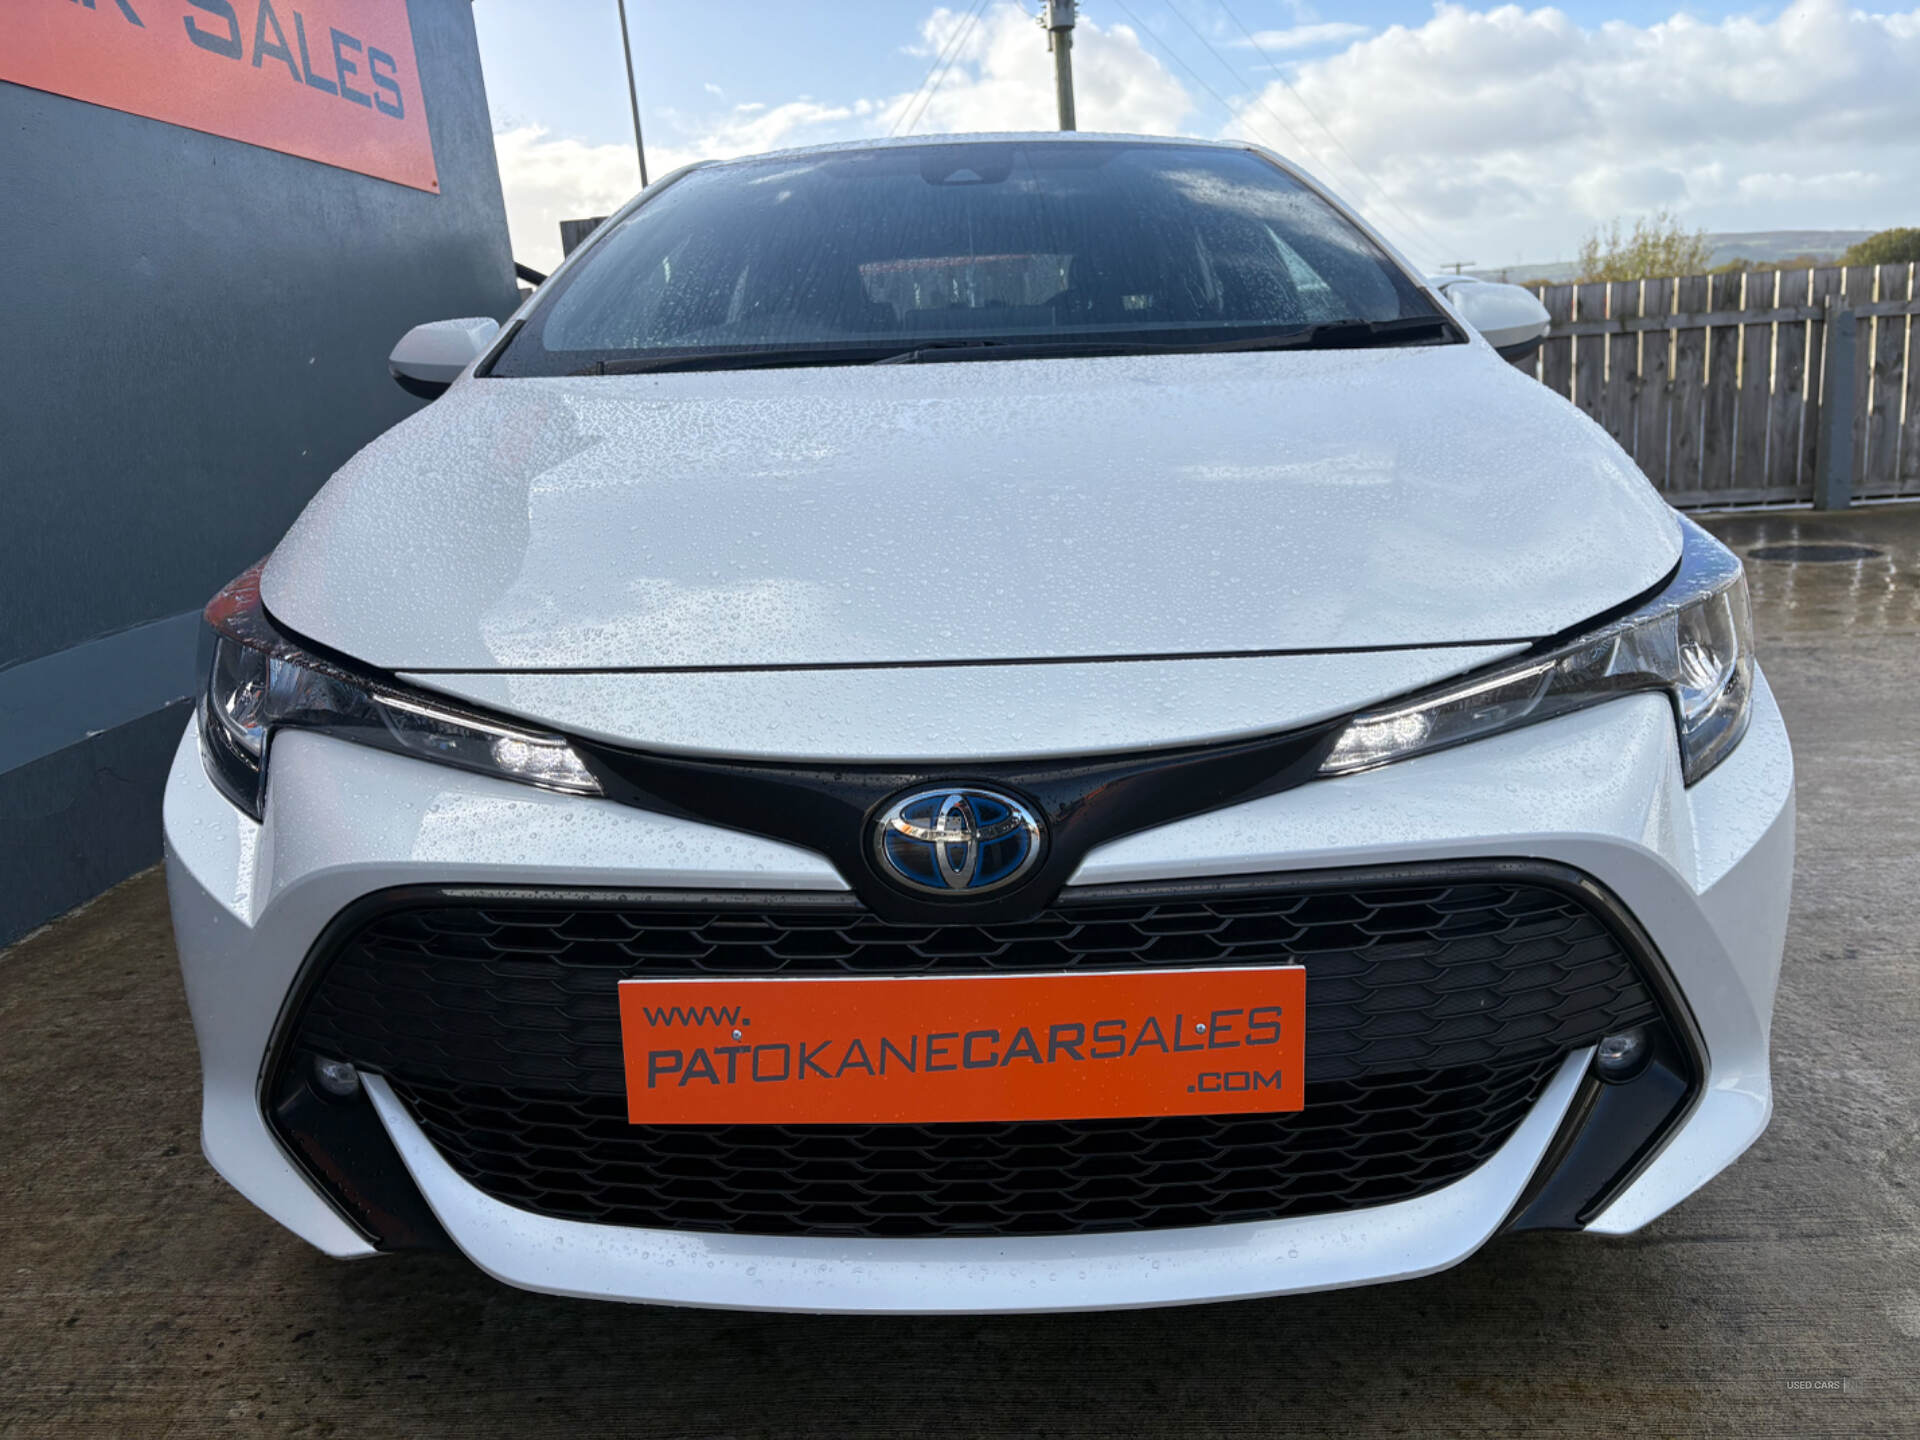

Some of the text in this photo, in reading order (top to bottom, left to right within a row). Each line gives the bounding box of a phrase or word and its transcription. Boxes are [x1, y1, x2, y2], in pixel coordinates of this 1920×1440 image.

[183, 0, 405, 120] SALES
[647, 1006, 1284, 1089] PATOKANECARSALES
[1187, 1070, 1283, 1094] .COM
